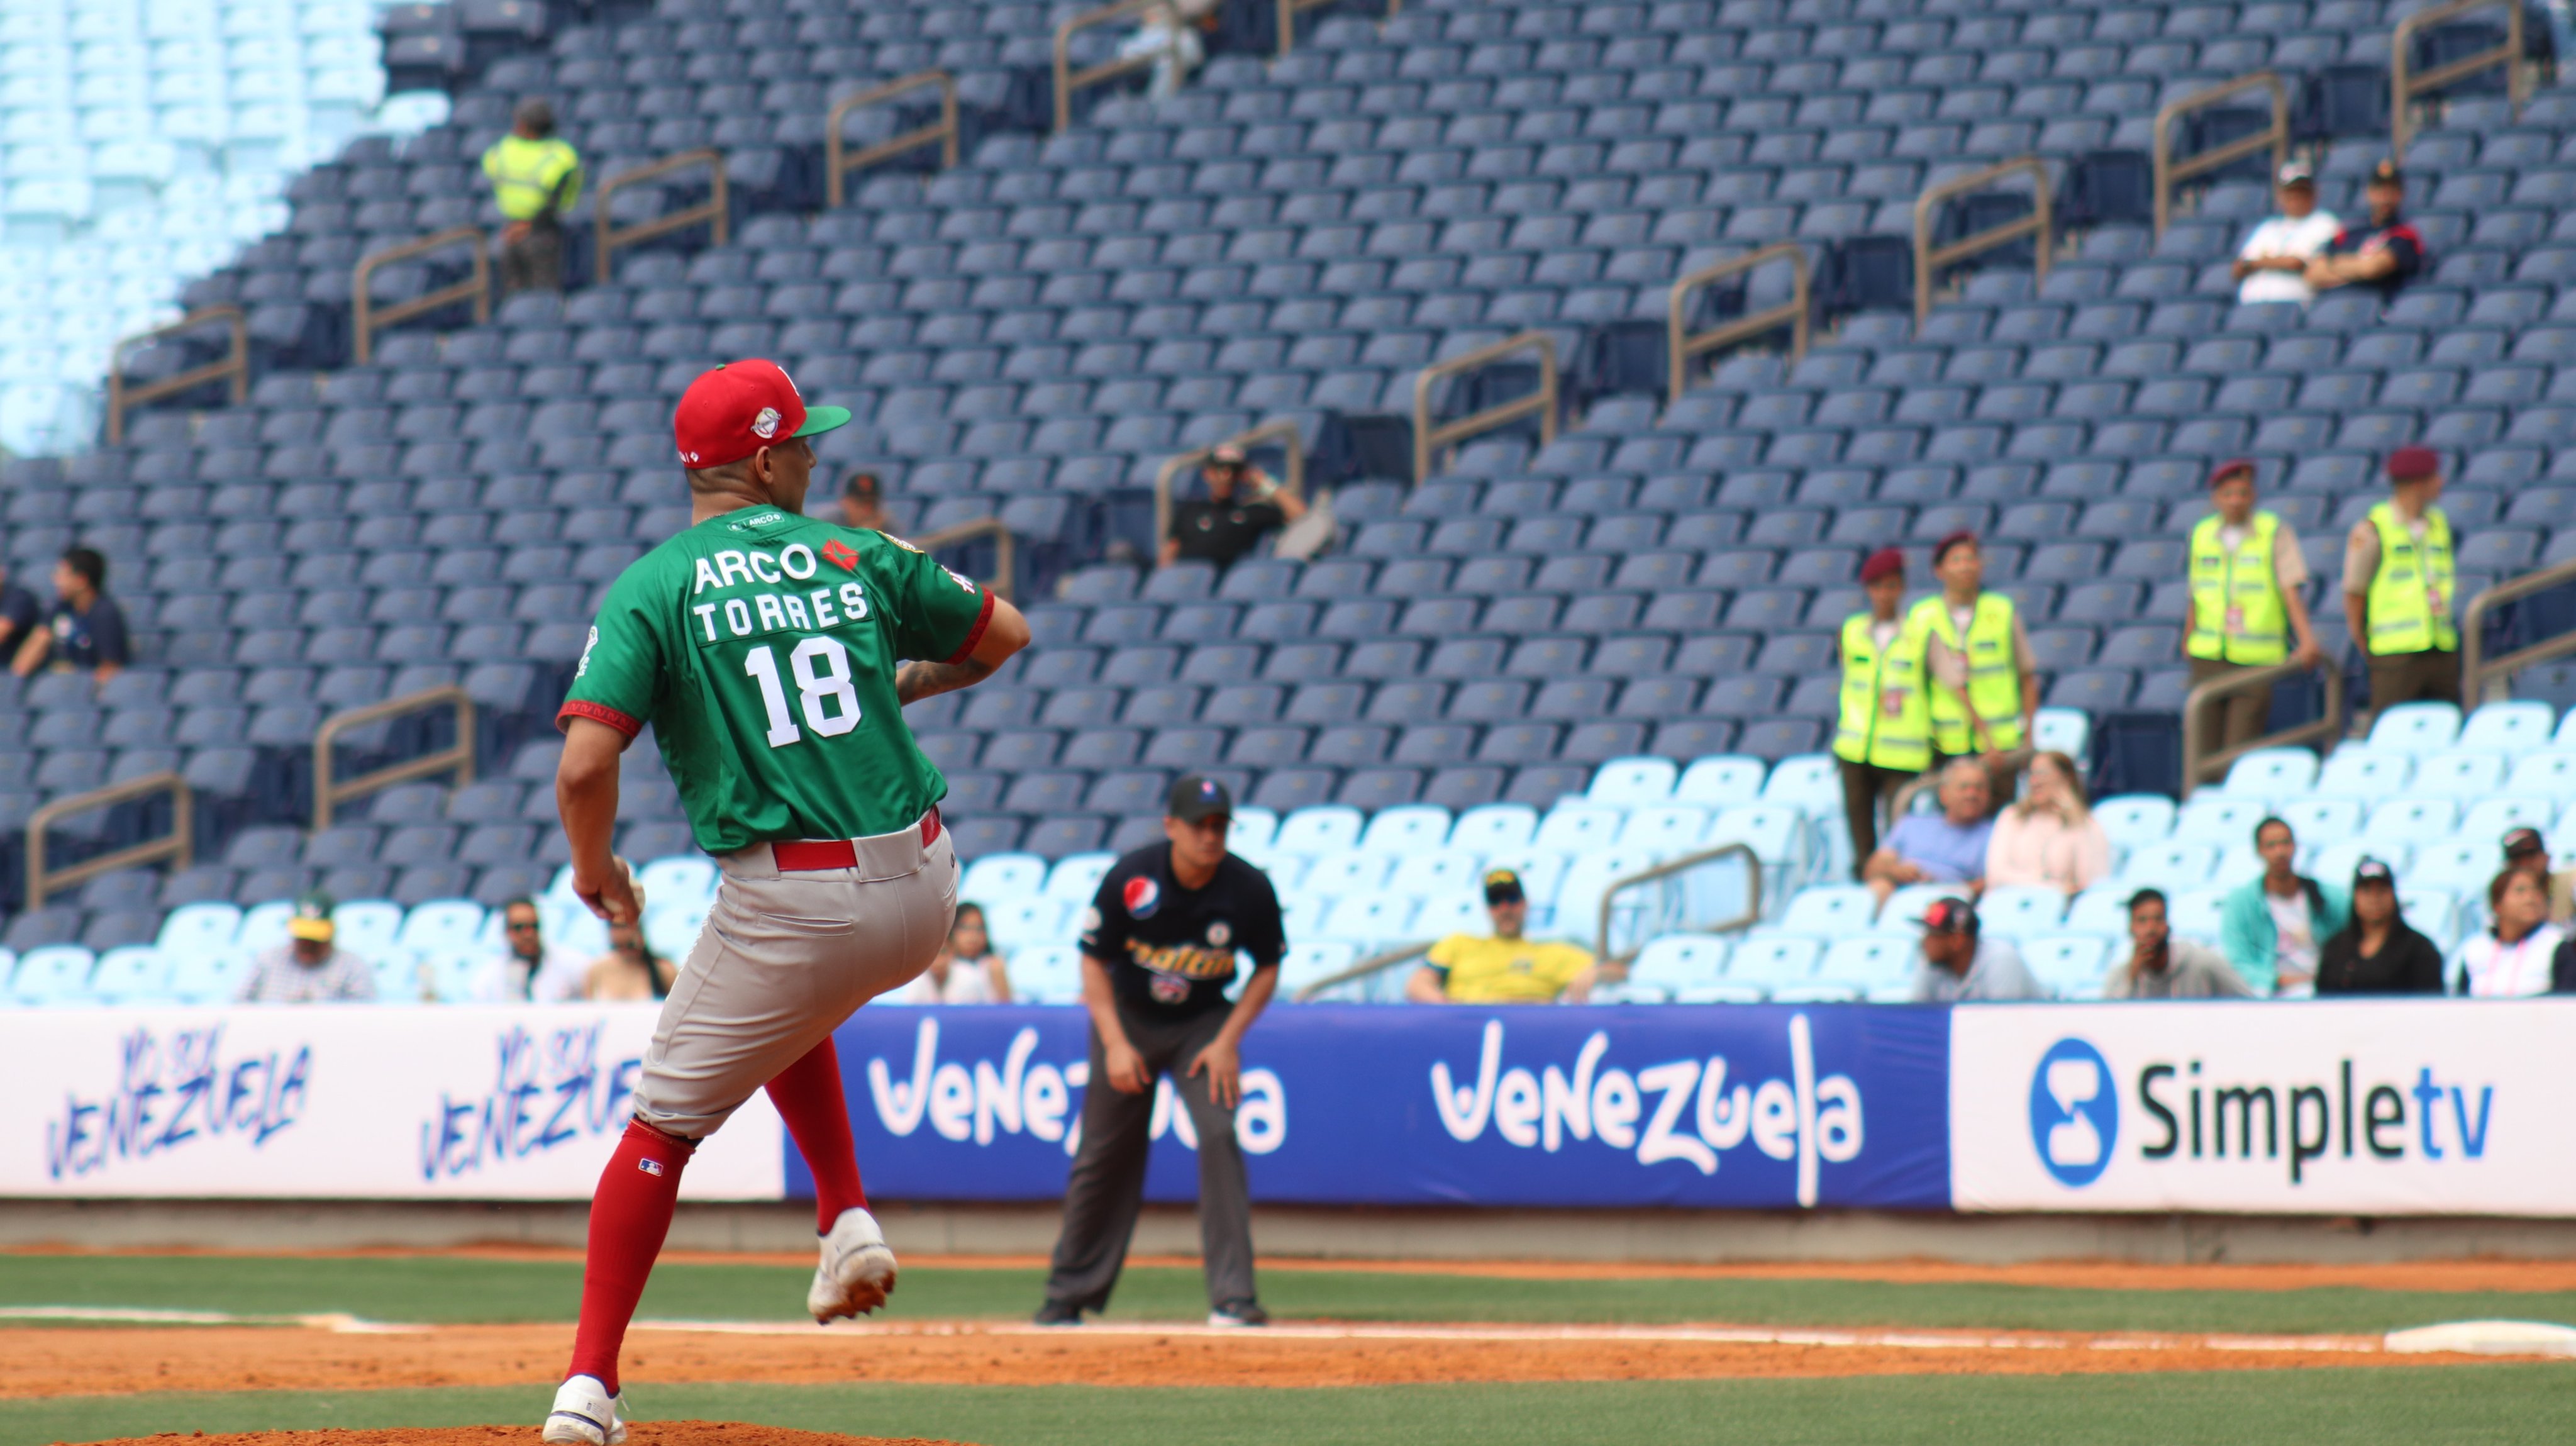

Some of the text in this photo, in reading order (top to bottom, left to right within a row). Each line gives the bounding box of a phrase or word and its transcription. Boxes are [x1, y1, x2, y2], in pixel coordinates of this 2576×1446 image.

[694, 543, 816, 594] ARCO
[749, 514, 774, 526] ARCO
[693, 582, 867, 642] TORRES
[745, 636, 861, 748] 18
[45, 1043, 312, 1179] VENEZUELA
[419, 1057, 643, 1181] VENEZUE
[2139, 1059, 2493, 1185] Simpletv
